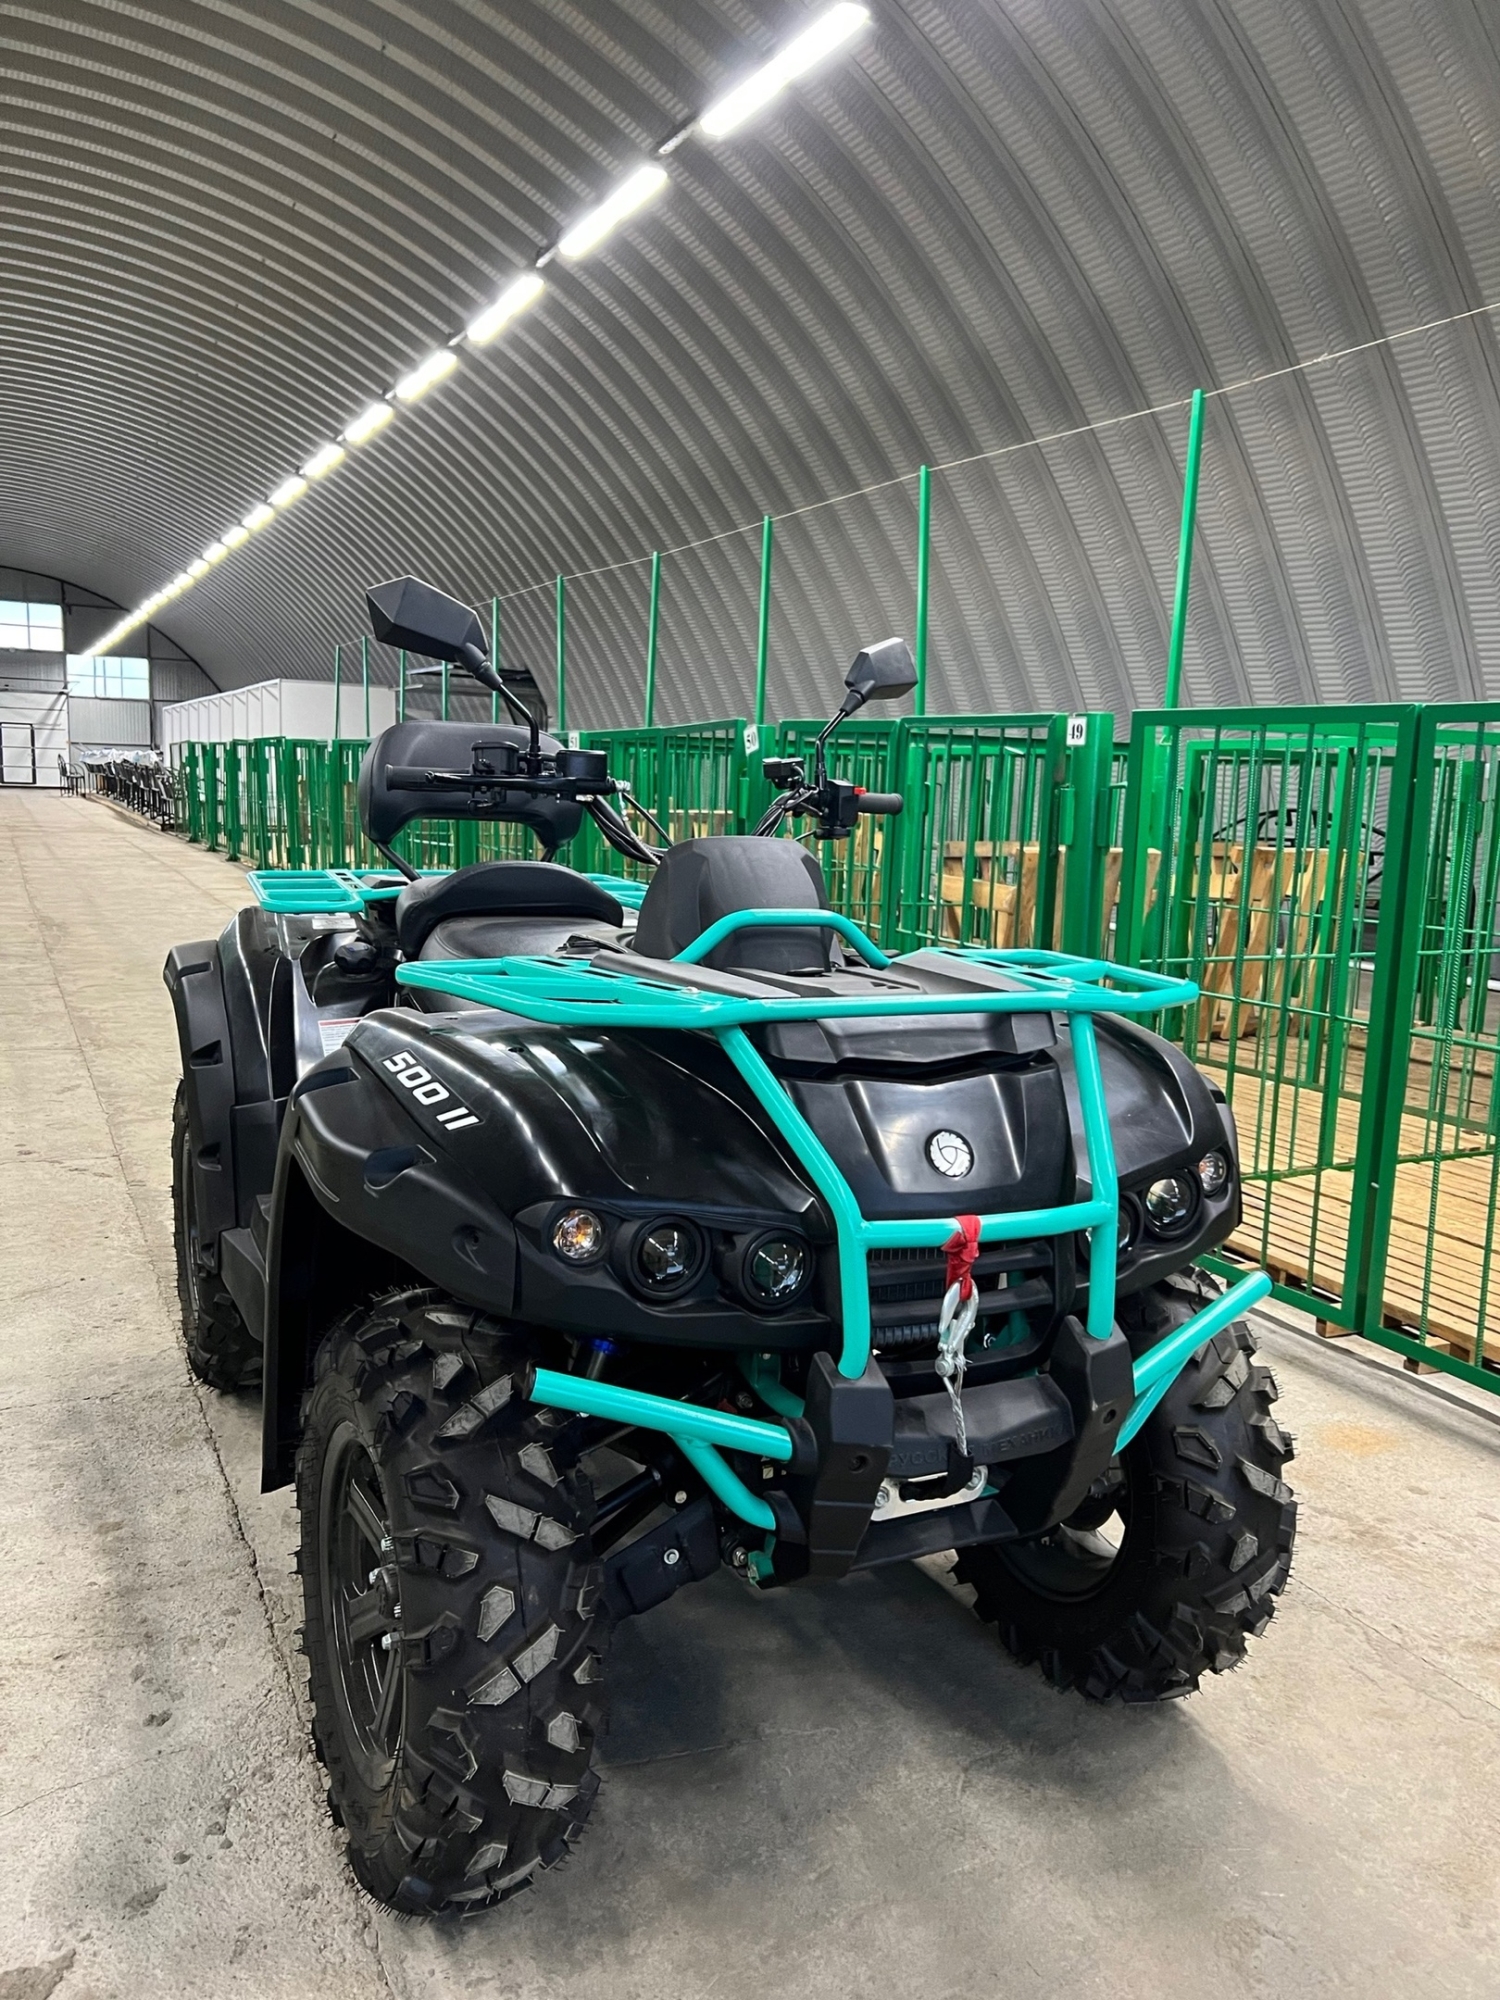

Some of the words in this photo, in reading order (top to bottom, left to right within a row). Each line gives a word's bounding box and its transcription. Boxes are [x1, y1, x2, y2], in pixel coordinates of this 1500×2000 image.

[746, 731, 757, 750] 50
[1069, 723, 1083, 740] 49
[569, 736, 578, 748] 51
[382, 1051, 450, 1106] 500
[436, 1106, 480, 1131] II
